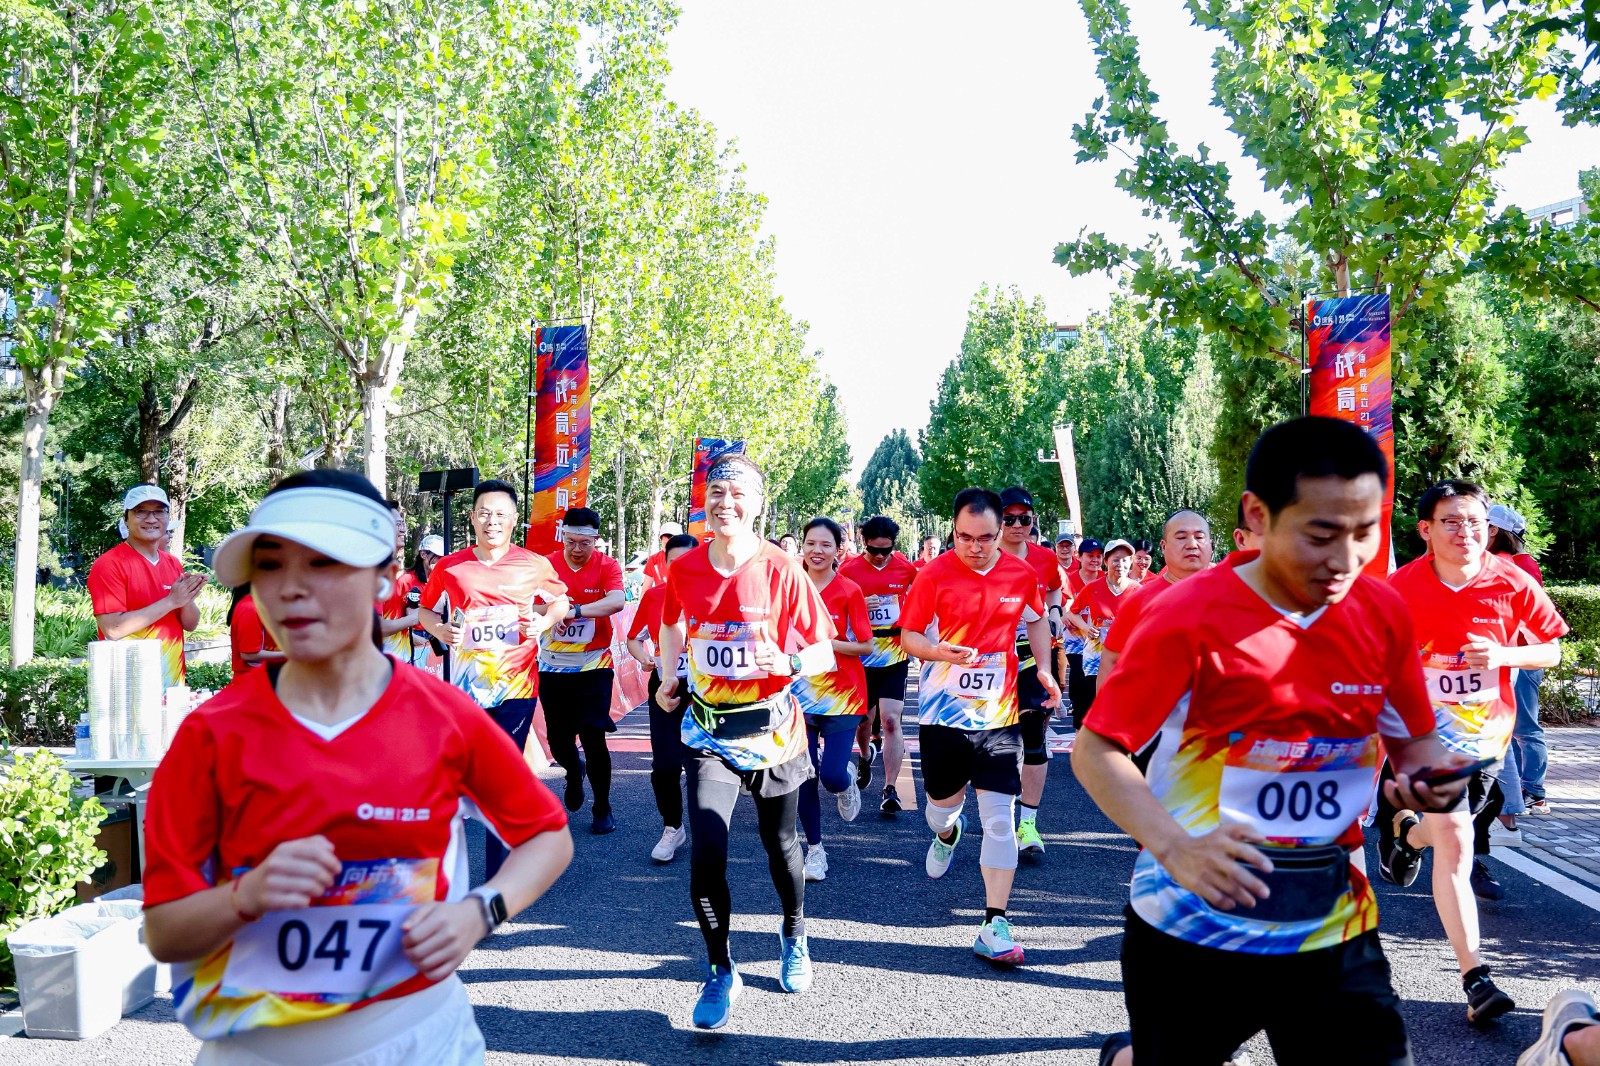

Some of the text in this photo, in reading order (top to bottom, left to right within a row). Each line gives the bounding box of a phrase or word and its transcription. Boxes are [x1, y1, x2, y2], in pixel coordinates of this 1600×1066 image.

[1335, 352, 1357, 423] 战高
[707, 646, 749, 668] 001
[959, 672, 995, 690] 057
[1439, 673, 1482, 694] 015
[1257, 780, 1341, 821] 008
[277, 917, 391, 971] 047
